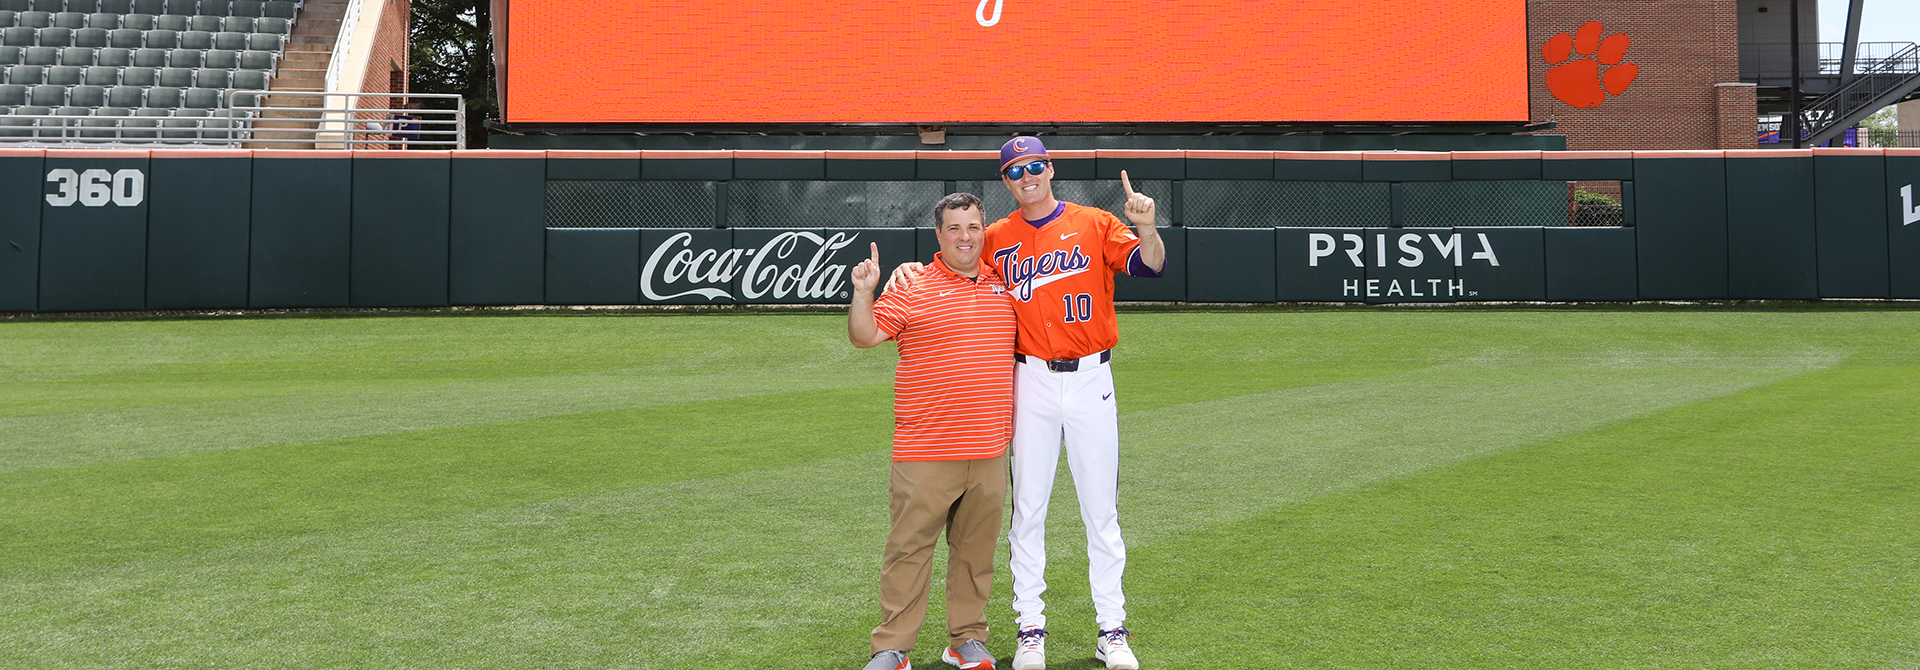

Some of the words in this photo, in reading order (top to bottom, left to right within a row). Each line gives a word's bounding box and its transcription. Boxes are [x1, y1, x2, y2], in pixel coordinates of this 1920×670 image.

[1013, 138, 1029, 153] C
[45, 168, 145, 207] 360
[640, 231, 860, 301] Coca-Cola
[1309, 233, 1500, 268] PRISMA
[993, 241, 1091, 303] Tigers
[1343, 278, 1464, 297] HEALTH
[1062, 293, 1093, 323] 10
